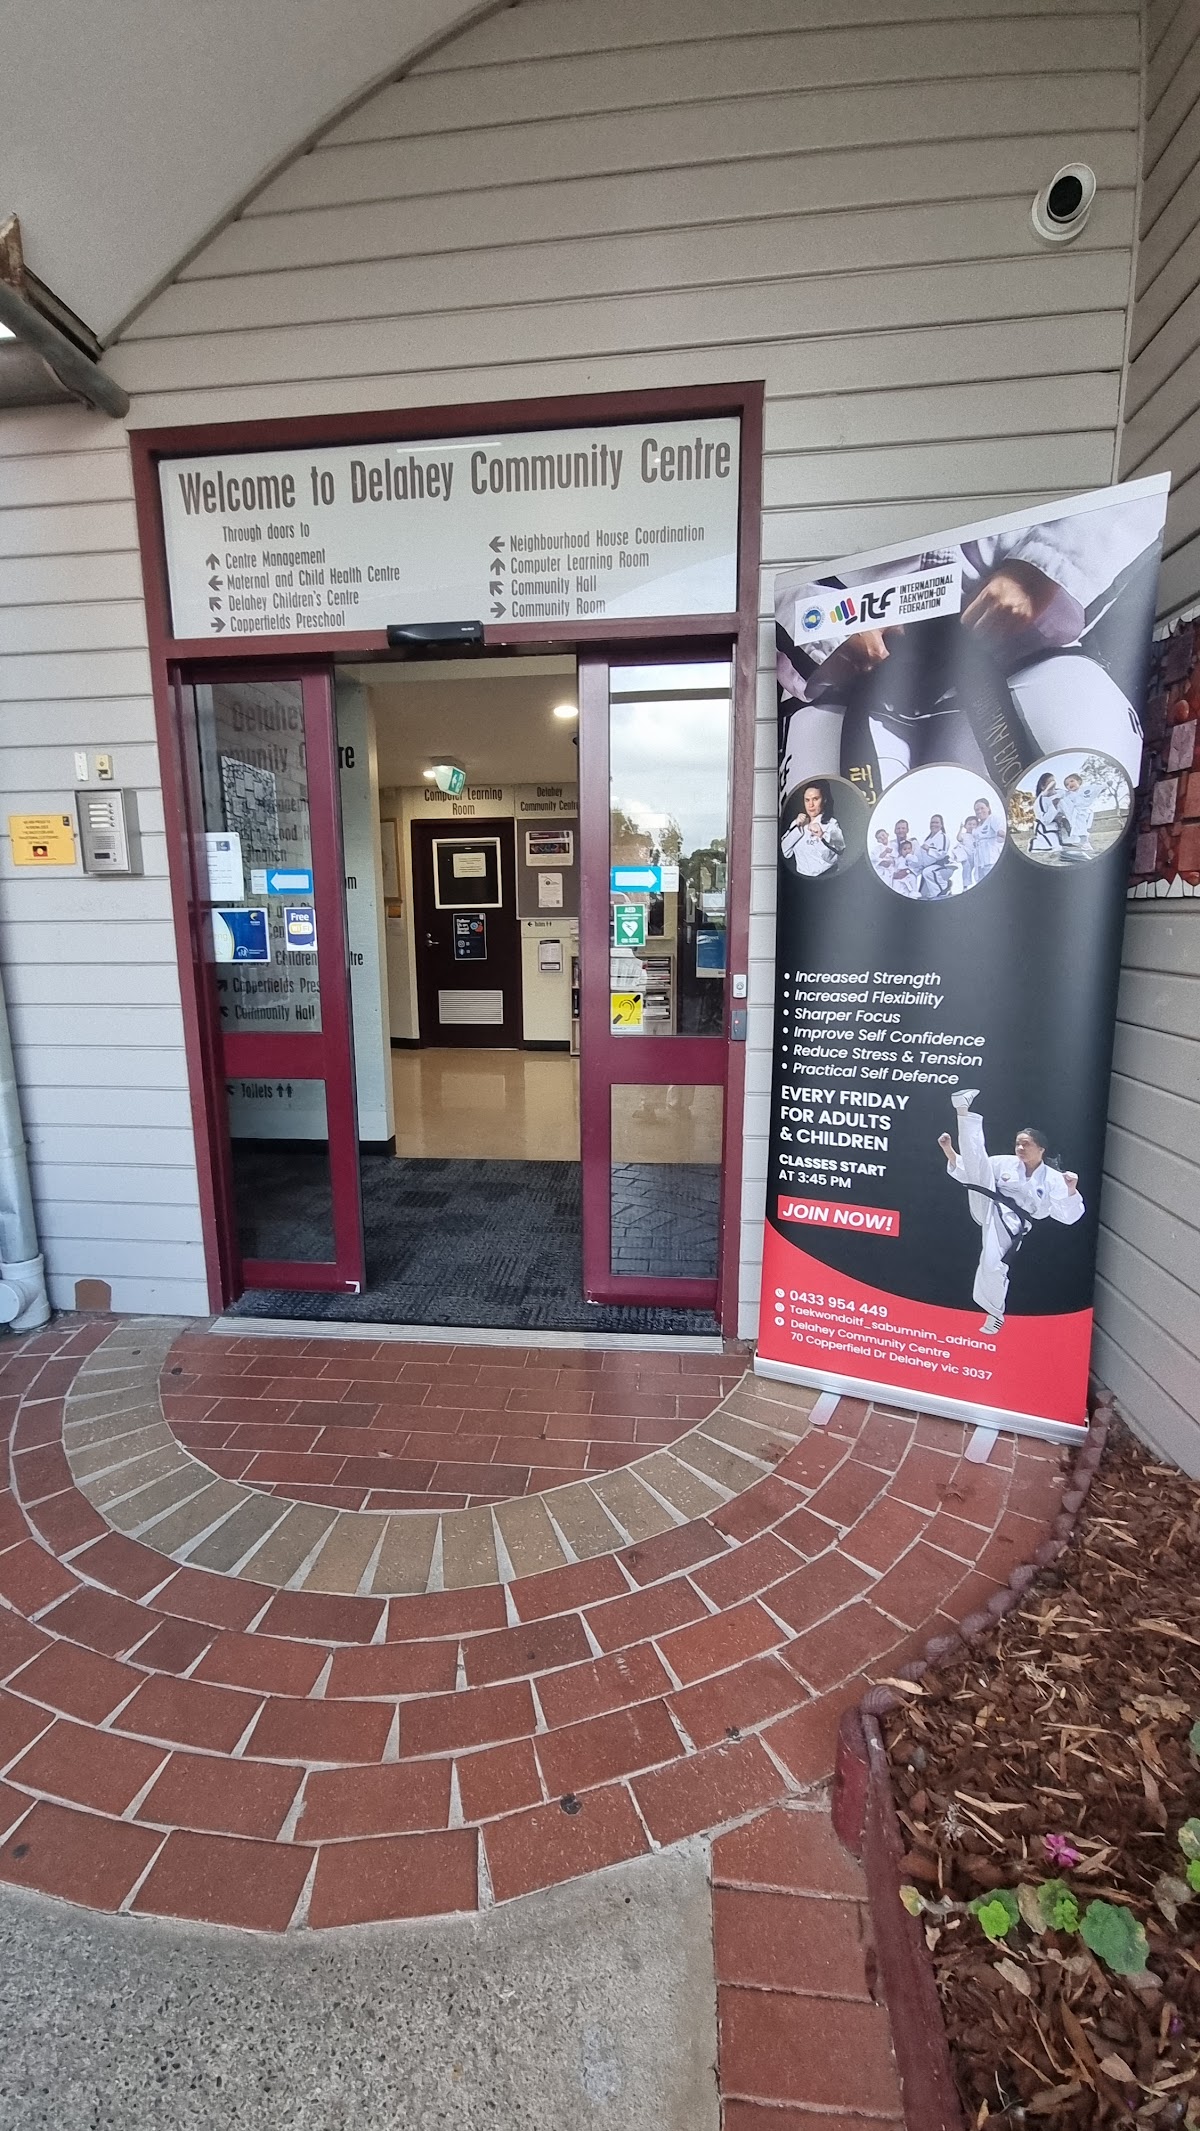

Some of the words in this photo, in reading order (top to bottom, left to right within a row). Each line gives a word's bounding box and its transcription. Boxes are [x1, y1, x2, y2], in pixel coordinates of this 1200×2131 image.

[179, 471, 295, 515] Welcome
[311, 466, 335, 506] to
[351, 456, 453, 503] Delahey
[471, 443, 623, 494] Community
[641, 437, 730, 483] Centre
[223, 524, 261, 542] Through
[268, 523, 294, 539] doors
[301, 522, 310, 537] to
[510, 531, 590, 553] Neighbourhood
[596, 529, 628, 547] House
[635, 525, 705, 544] Coordination
[226, 552, 257, 569] Centre
[263, 548, 325, 567] Management
[511, 556, 560, 575] Computer
[567, 553, 612, 572] Learning
[619, 551, 649, 567] Room
[227, 572, 269, 590] Maternal
[275, 570, 293, 588] and
[299, 569, 324, 587] Child
[330, 566, 362, 585] Health
[368, 565, 400, 582] Centre
[511, 577, 570, 596] Community
[576, 575, 597, 593] Hall
[900, 574, 953, 594] INTERNATIONAL
[228, 595, 267, 612] Delahey
[273, 590, 321, 610] Children's
[327, 590, 359, 606] Centre
[900, 586, 946, 604] TAEKWON-DO
[512, 600, 570, 618] Community
[577, 598, 605, 614] Room
[899, 598, 941, 614] FEDERATION
[230, 613, 290, 633] Copperfields
[296, 611, 345, 629] Preschool
[468, 788, 502, 801] Learning
[537, 787, 562, 797] Delahey
[453, 803, 475, 815] Room
[521, 801, 556, 811] Community
[291, 913, 309, 921] Free
[233, 978, 294, 993] Copperfields
[795, 971, 869, 984] Increased
[873, 972, 941, 988] Strength
[795, 990, 868, 1003] Increased
[872, 991, 944, 1009] Flexibility
[235, 1005, 290, 1021] Community
[296, 1005, 315, 1019] Hall
[794, 1008, 852, 1024] Sharper
[856, 1010, 900, 1023] Focus
[794, 1026, 854, 1042] Improve
[858, 1029, 887, 1042] Self
[890, 1031, 985, 1046] Confidence
[793, 1044, 848, 1059] Reduce
[852, 1048, 897, 1061] Stress
[902, 1051, 914, 1063] &
[919, 1051, 983, 1066] Tension
[793, 1062, 856, 1078] Practical
[860, 1067, 889, 1080] Self
[892, 1069, 959, 1084] Defence
[241, 1083, 272, 1098] Toilets
[782, 1085, 836, 1104] EVERY
[840, 1091, 909, 1110] FRIDAY
[781, 1106, 814, 1123] FOR
[818, 1111, 891, 1130] ADULTS
[780, 1127, 793, 1142] &
[797, 1129, 888, 1151] CHILDREN
[779, 1154, 837, 1171] CLASSES
[840, 1161, 886, 1176] START
[779, 1170, 795, 1181] AT
[798, 1172, 827, 1185] 3:45
[830, 1176, 851, 1188] PM
[783, 1203, 829, 1222] JOIN
[833, 1209, 893, 1231] NOW!
[790, 1290, 824, 1306] 0433
[828, 1296, 855, 1312] 954
[859, 1303, 888, 1318] 449
[790, 1319, 835, 1337] Delahey
[837, 1329, 906, 1351] Community
[909, 1342, 950, 1359] Centre
[790, 1332, 803, 1342] 70
[806, 1335, 871, 1357] Copperfield
[874, 1349, 886, 1359] Dr
[889, 1352, 938, 1372] Delahey
[941, 1363, 959, 1374] vic
[962, 1367, 992, 1381] 3037
